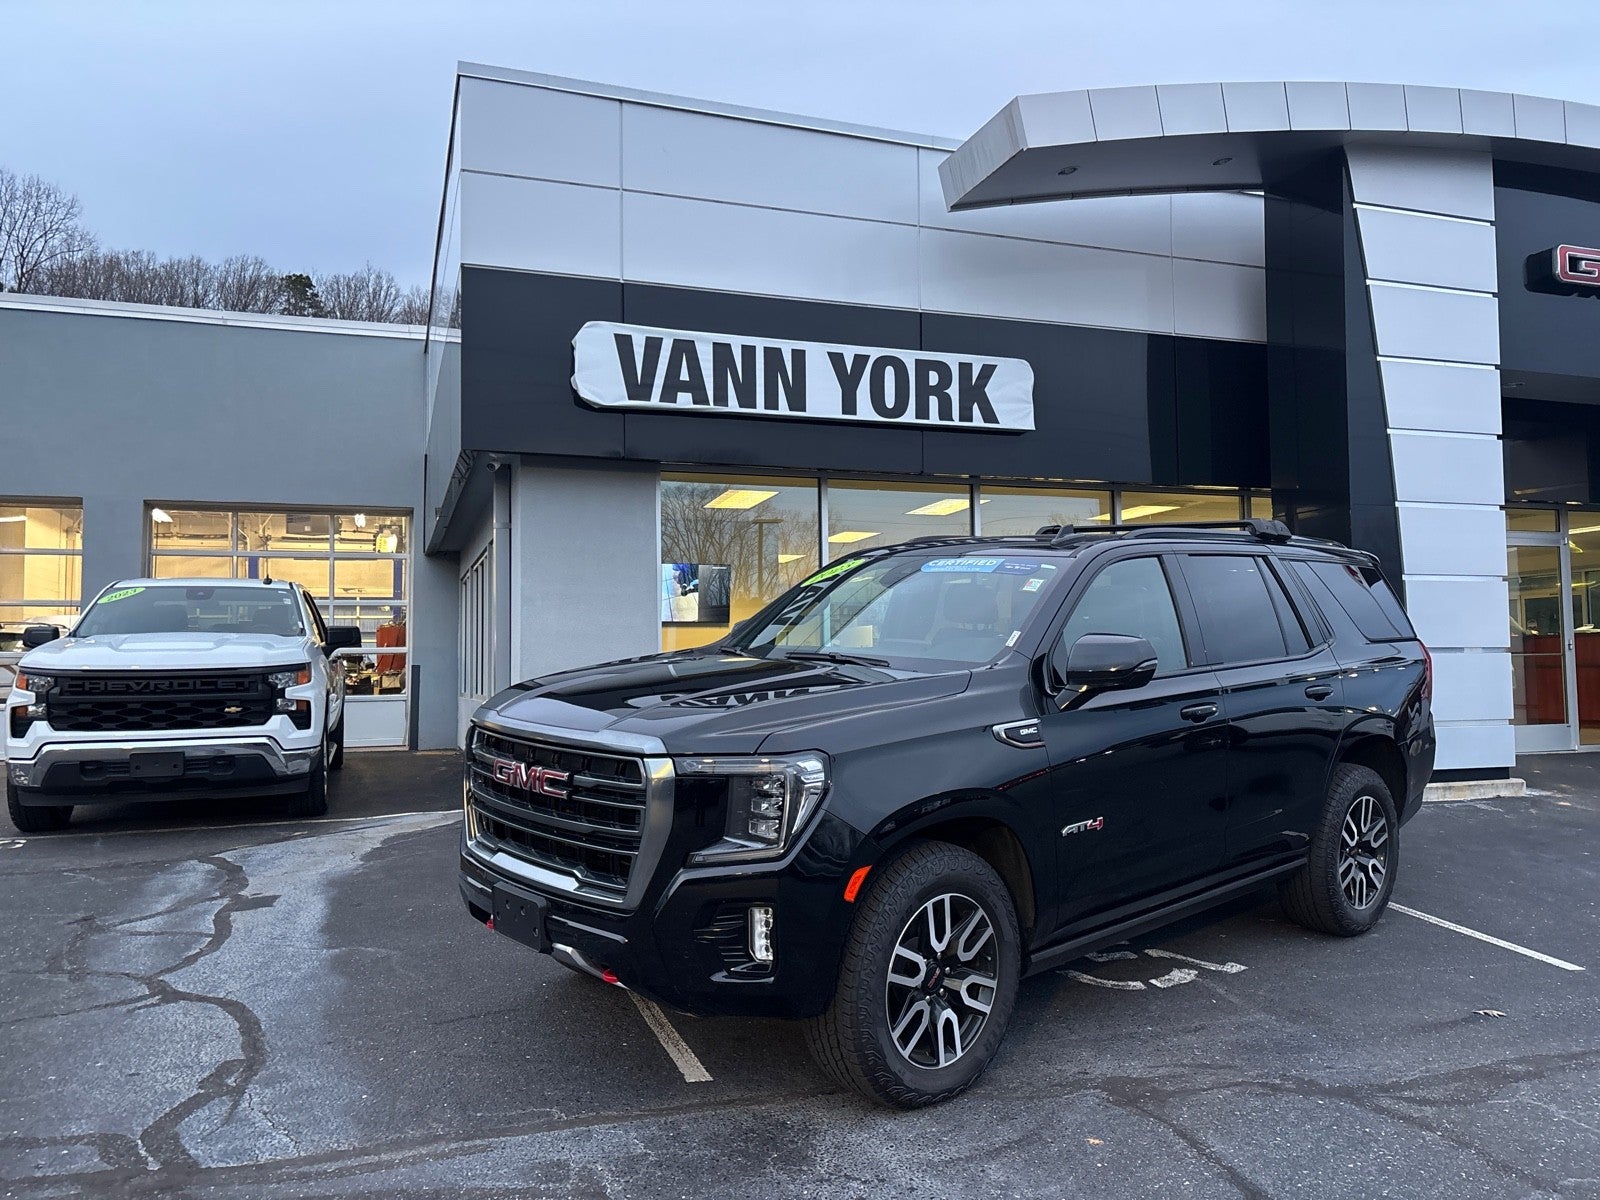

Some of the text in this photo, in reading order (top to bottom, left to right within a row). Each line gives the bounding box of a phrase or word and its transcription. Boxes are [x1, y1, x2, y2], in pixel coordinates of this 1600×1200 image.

[613, 333, 1000, 424] VANN YORK
[928, 558, 997, 567] CERTIFIED
[64, 679, 255, 692] CHEVROLET
[1019, 727, 1038, 736] GMC
[493, 758, 570, 799] GMC
[1061, 816, 1104, 837] AT4
